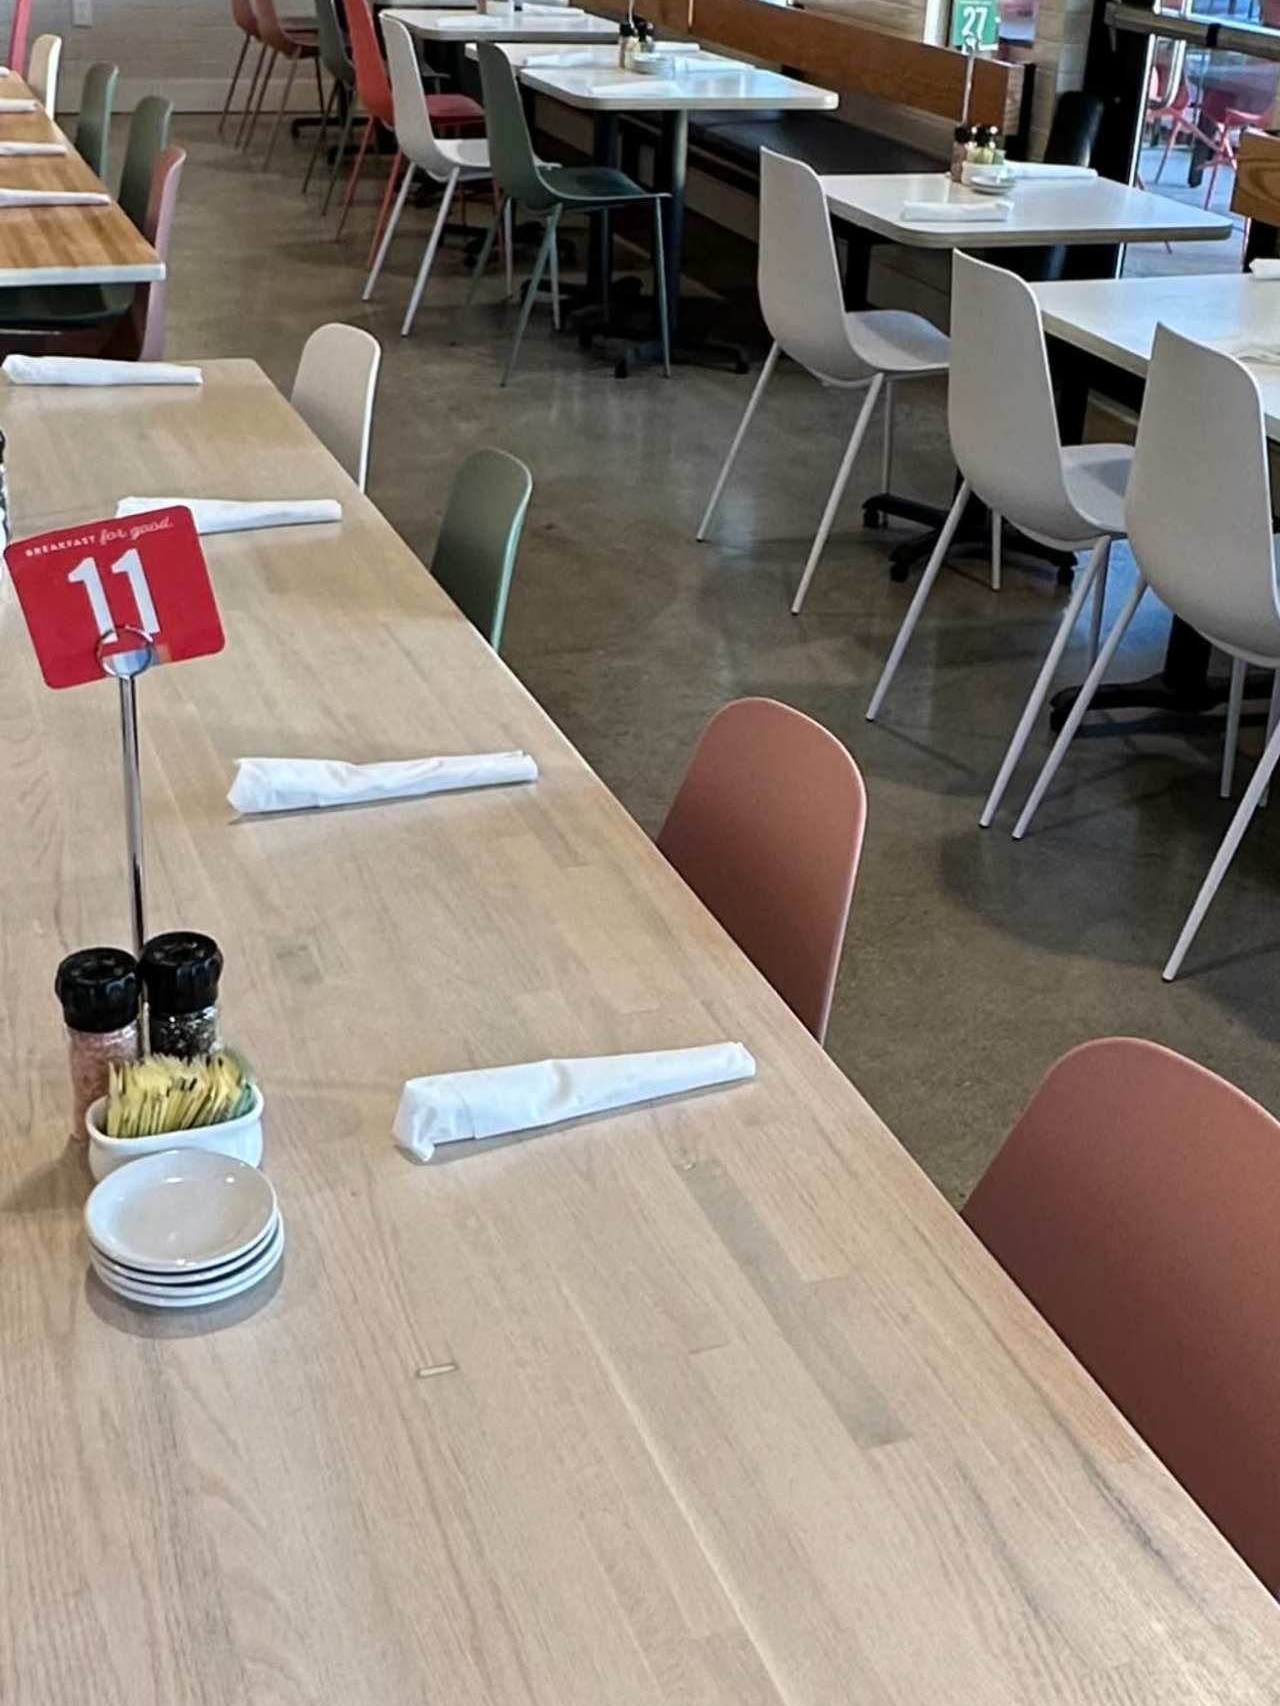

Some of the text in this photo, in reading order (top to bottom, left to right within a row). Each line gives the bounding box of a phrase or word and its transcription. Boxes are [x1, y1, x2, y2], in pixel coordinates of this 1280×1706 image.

[962, 6, 988, 41] 27
[25, 534, 96, 558] BREAKFAST
[99, 528, 128, 546] for
[67, 548, 161, 644] 11
